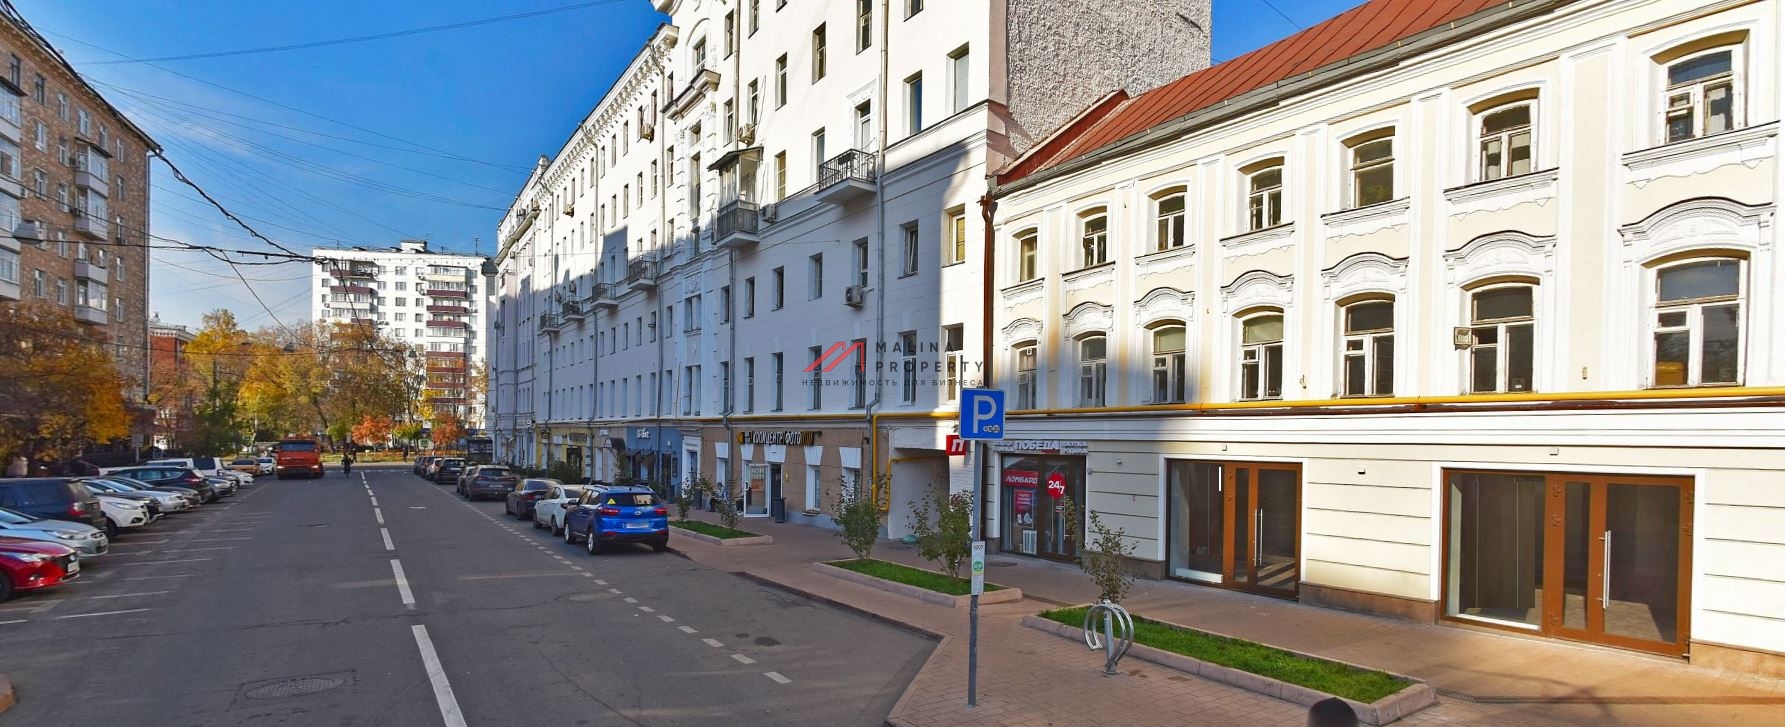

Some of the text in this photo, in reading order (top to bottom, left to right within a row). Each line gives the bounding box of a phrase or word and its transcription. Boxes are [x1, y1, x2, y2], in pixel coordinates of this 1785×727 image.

[972, 395, 997, 433] P
[951, 438, 965, 452] П
[1014, 440, 1060, 450] ПОБЕДА
[1005, 475, 1038, 484] ЛОМБАРД
